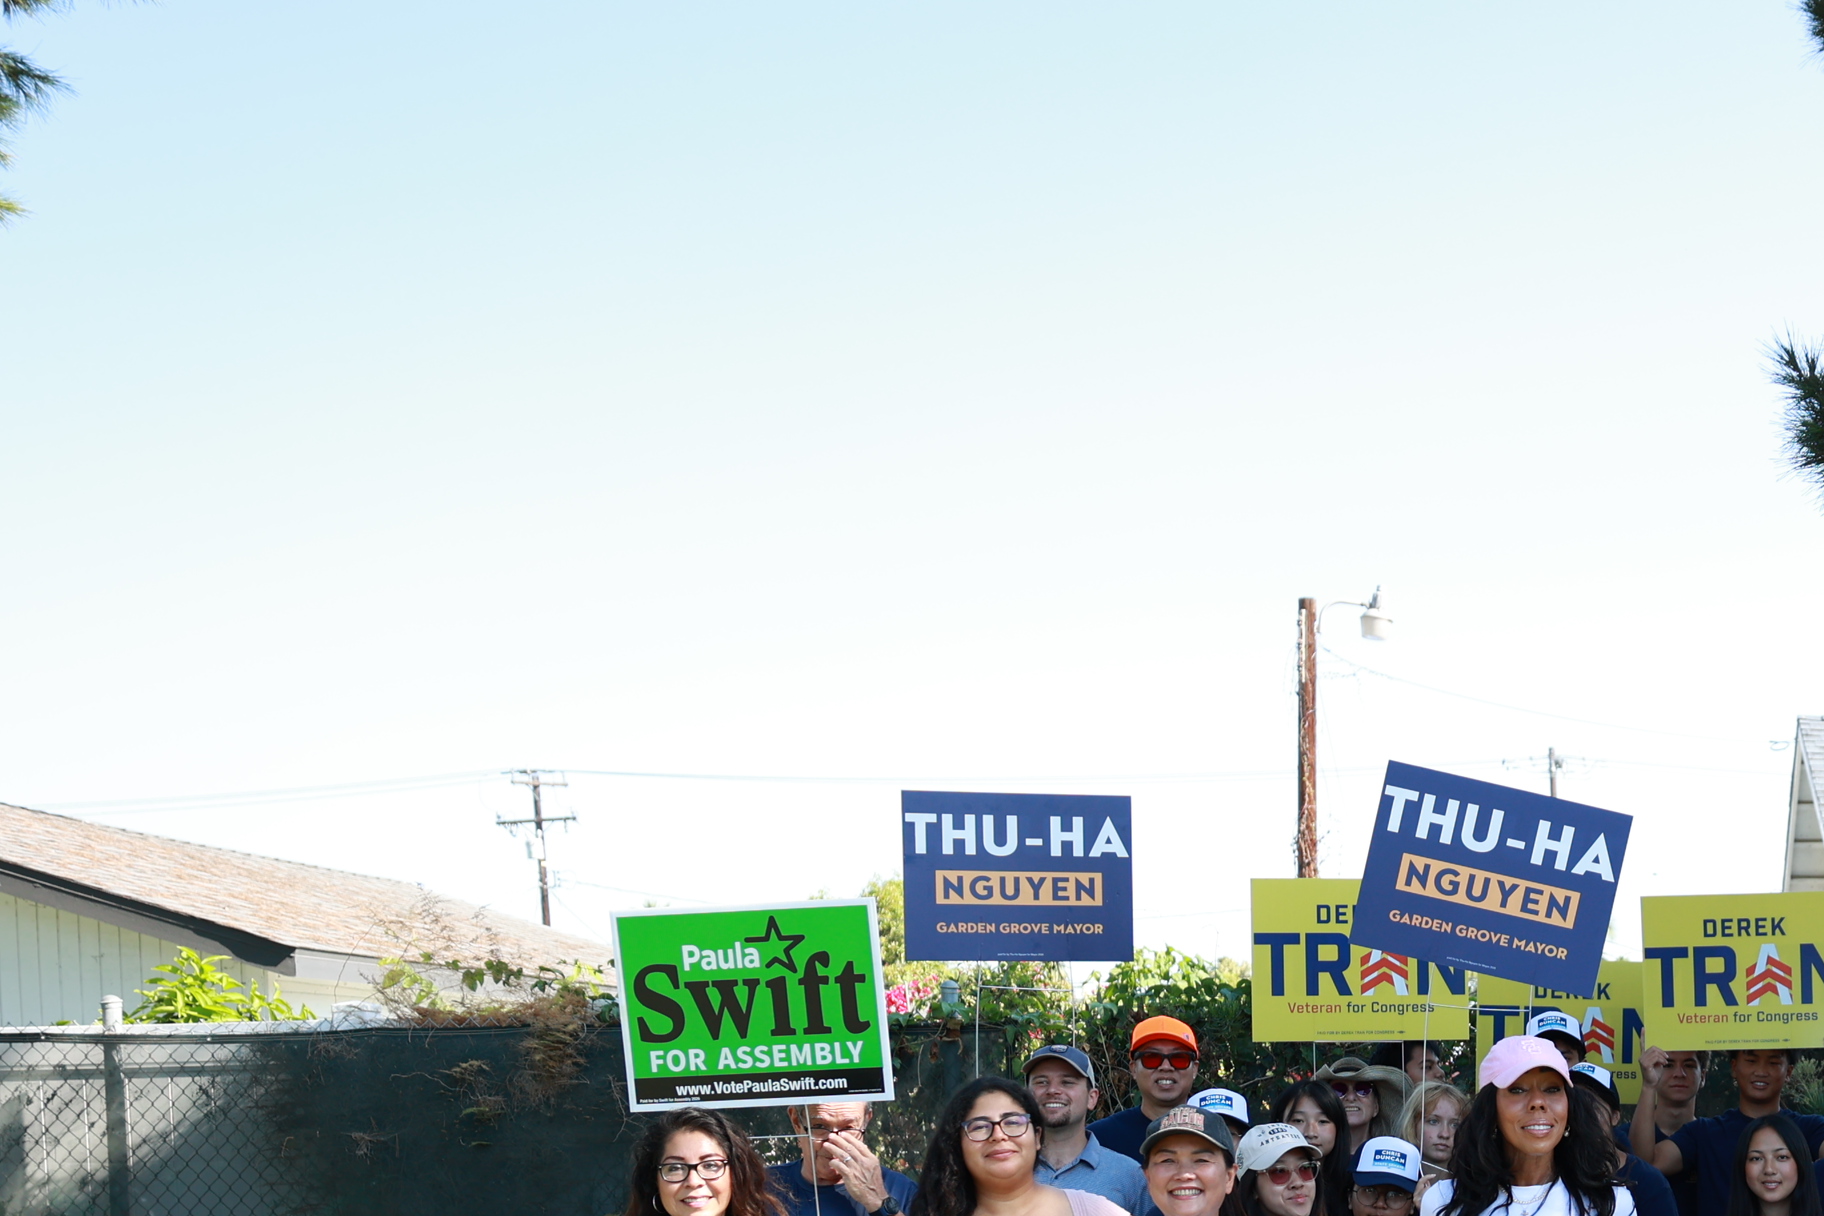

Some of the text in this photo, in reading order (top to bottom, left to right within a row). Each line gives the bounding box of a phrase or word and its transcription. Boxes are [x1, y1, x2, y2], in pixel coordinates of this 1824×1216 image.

[905, 812, 1129, 858] THU-HA
[1384, 784, 1615, 883] THU-HA
[943, 874, 1096, 902] NGUYEN
[1404, 859, 1572, 923] NGUYEN
[936, 922, 1103, 935] GARDEN GROVE MAYOR
[1389, 910, 1568, 960] GARDEN GROVE MAYOR
[1703, 917, 1786, 937] DEREK
[681, 941, 760, 971] Paula
[1254, 933, 1466, 996] TRAN
[633, 950, 871, 1043] Swift
[1288, 1001, 1434, 1015] Veteran for Congress
[1677, 1011, 1818, 1024] Veteran for Congress
[649, 1040, 863, 1073] FOR ASSEMBLY
[675, 1077, 848, 1096] www.VotePaulaSwift.com
[1375, 1155, 1405, 1164] DUNCAN
